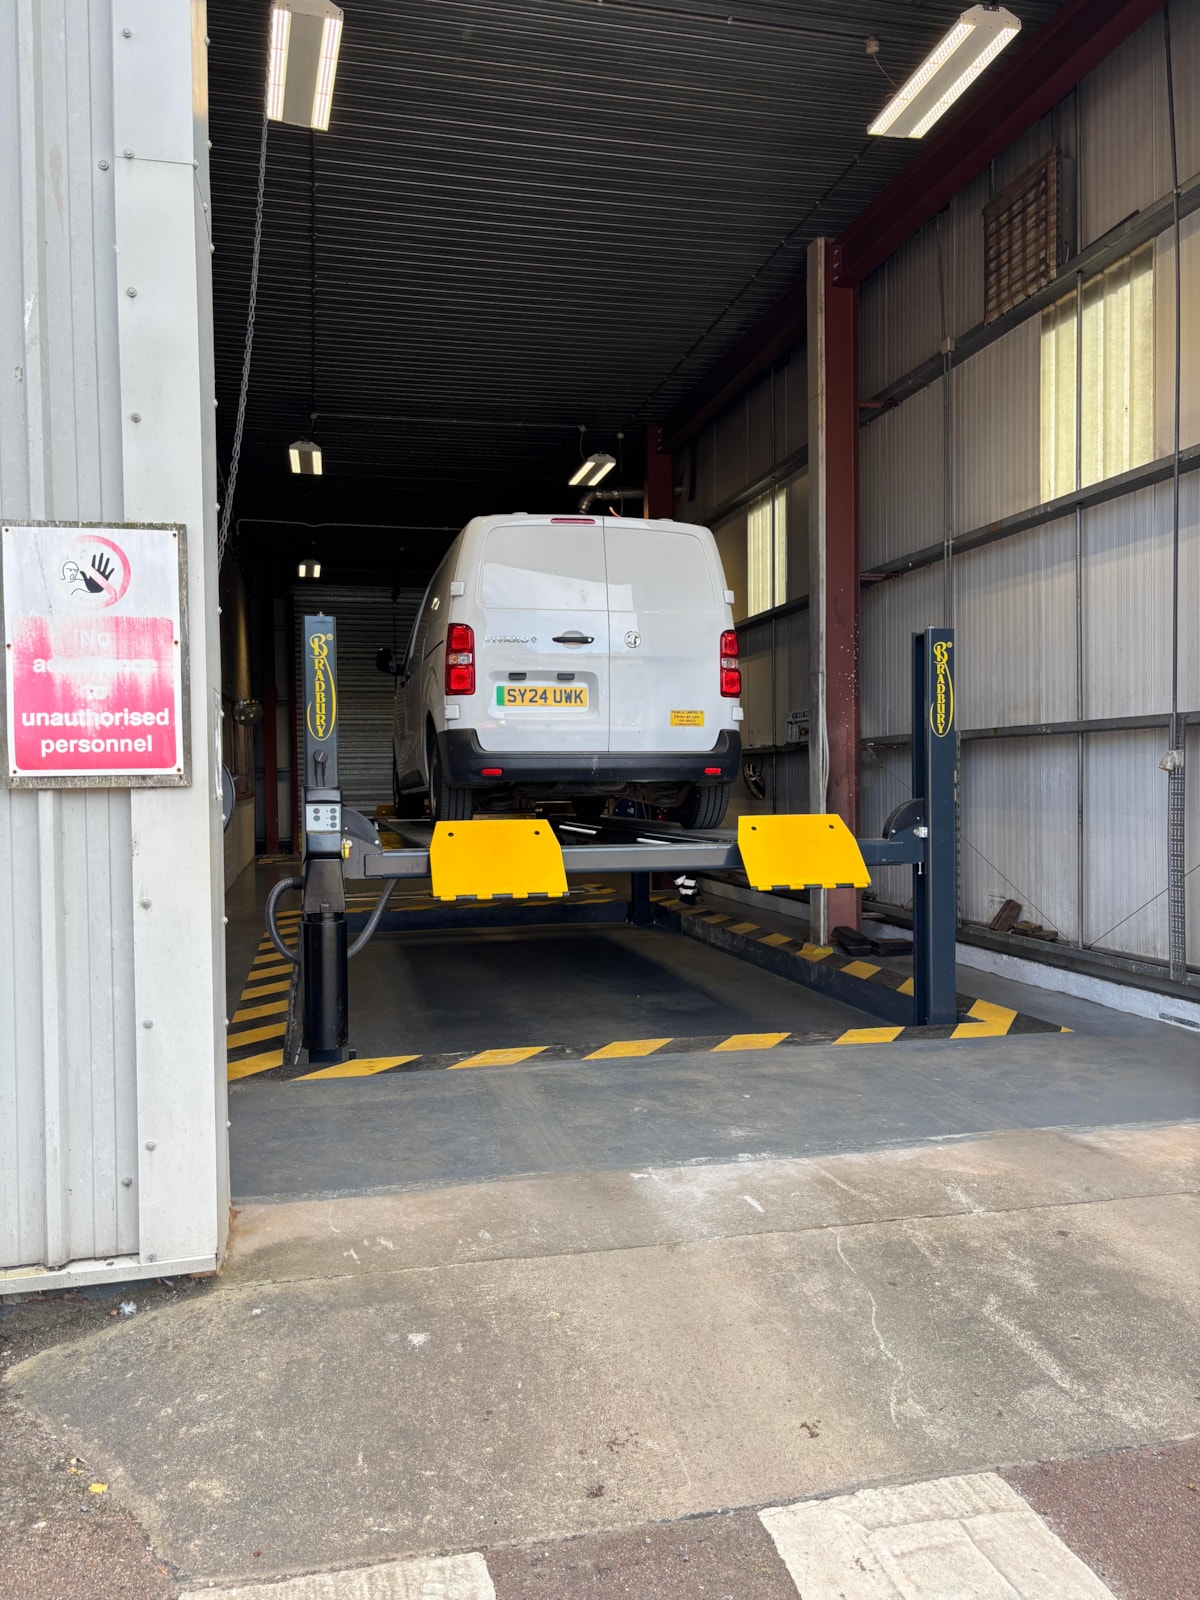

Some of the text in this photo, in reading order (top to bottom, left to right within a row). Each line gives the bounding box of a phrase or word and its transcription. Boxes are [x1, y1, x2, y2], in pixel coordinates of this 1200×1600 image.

[79, 629, 111, 649] No
[86, 683, 108, 700] to
[309, 633, 331, 737] BRADBURY
[933, 641, 951, 735] BRADBURY
[507, 688, 583, 704] SY24 UWK
[21, 707, 170, 728] unauthorised
[41, 734, 153, 758] personnel
